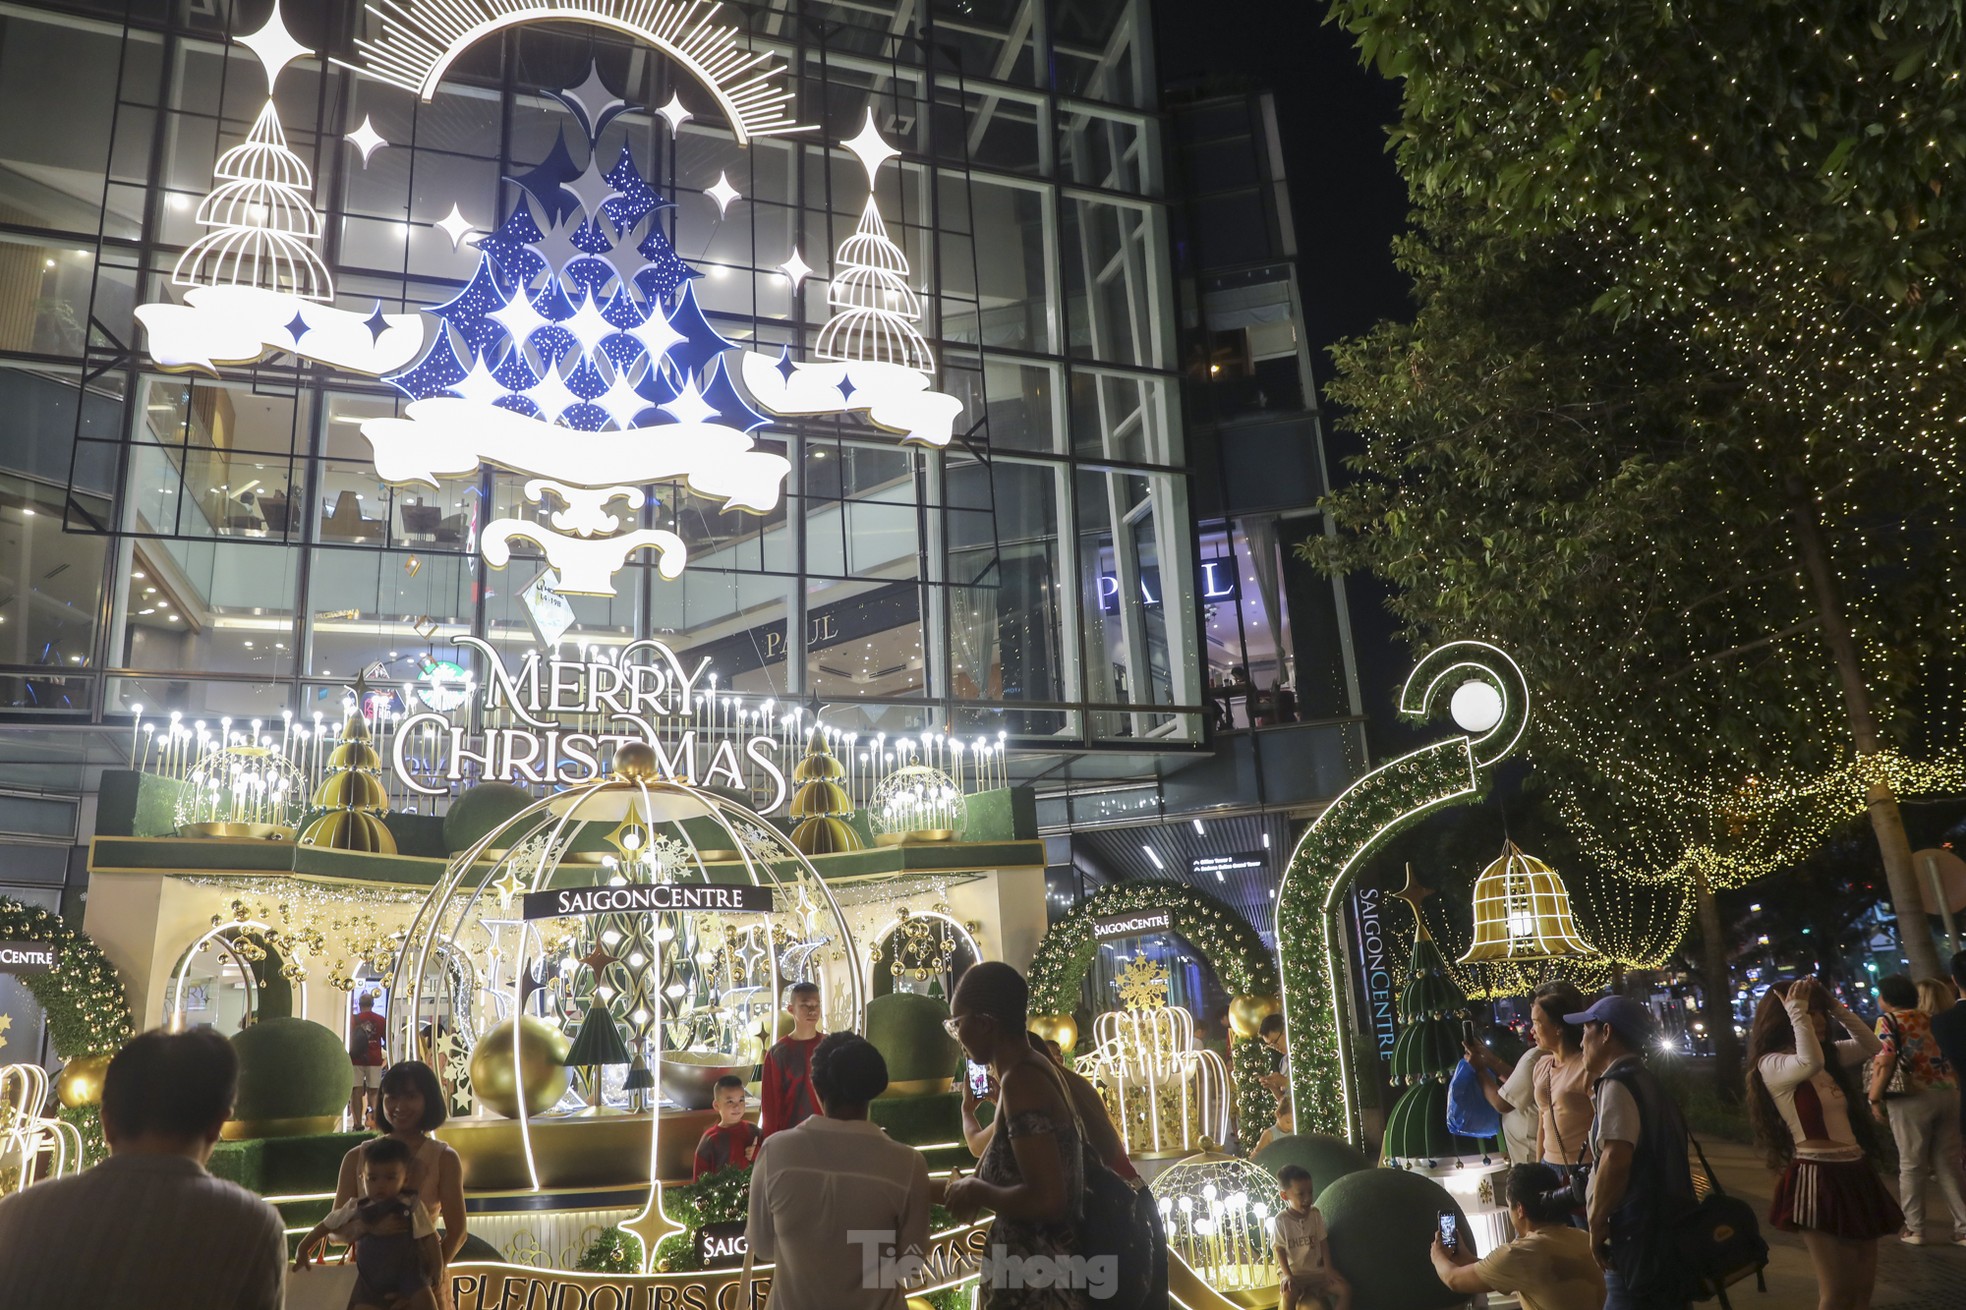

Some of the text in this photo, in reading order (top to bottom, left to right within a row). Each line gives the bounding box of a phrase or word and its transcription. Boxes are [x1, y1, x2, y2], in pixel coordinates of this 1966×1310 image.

[451, 635, 713, 727] MERRY
[558, 886, 743, 913] SAIGONCENTRE
[1094, 915, 1169, 936] SAIGONCENTRE
[0, 948, 53, 965] CENTRE
[1359, 888, 1395, 1061] SAIGONCENTRE
